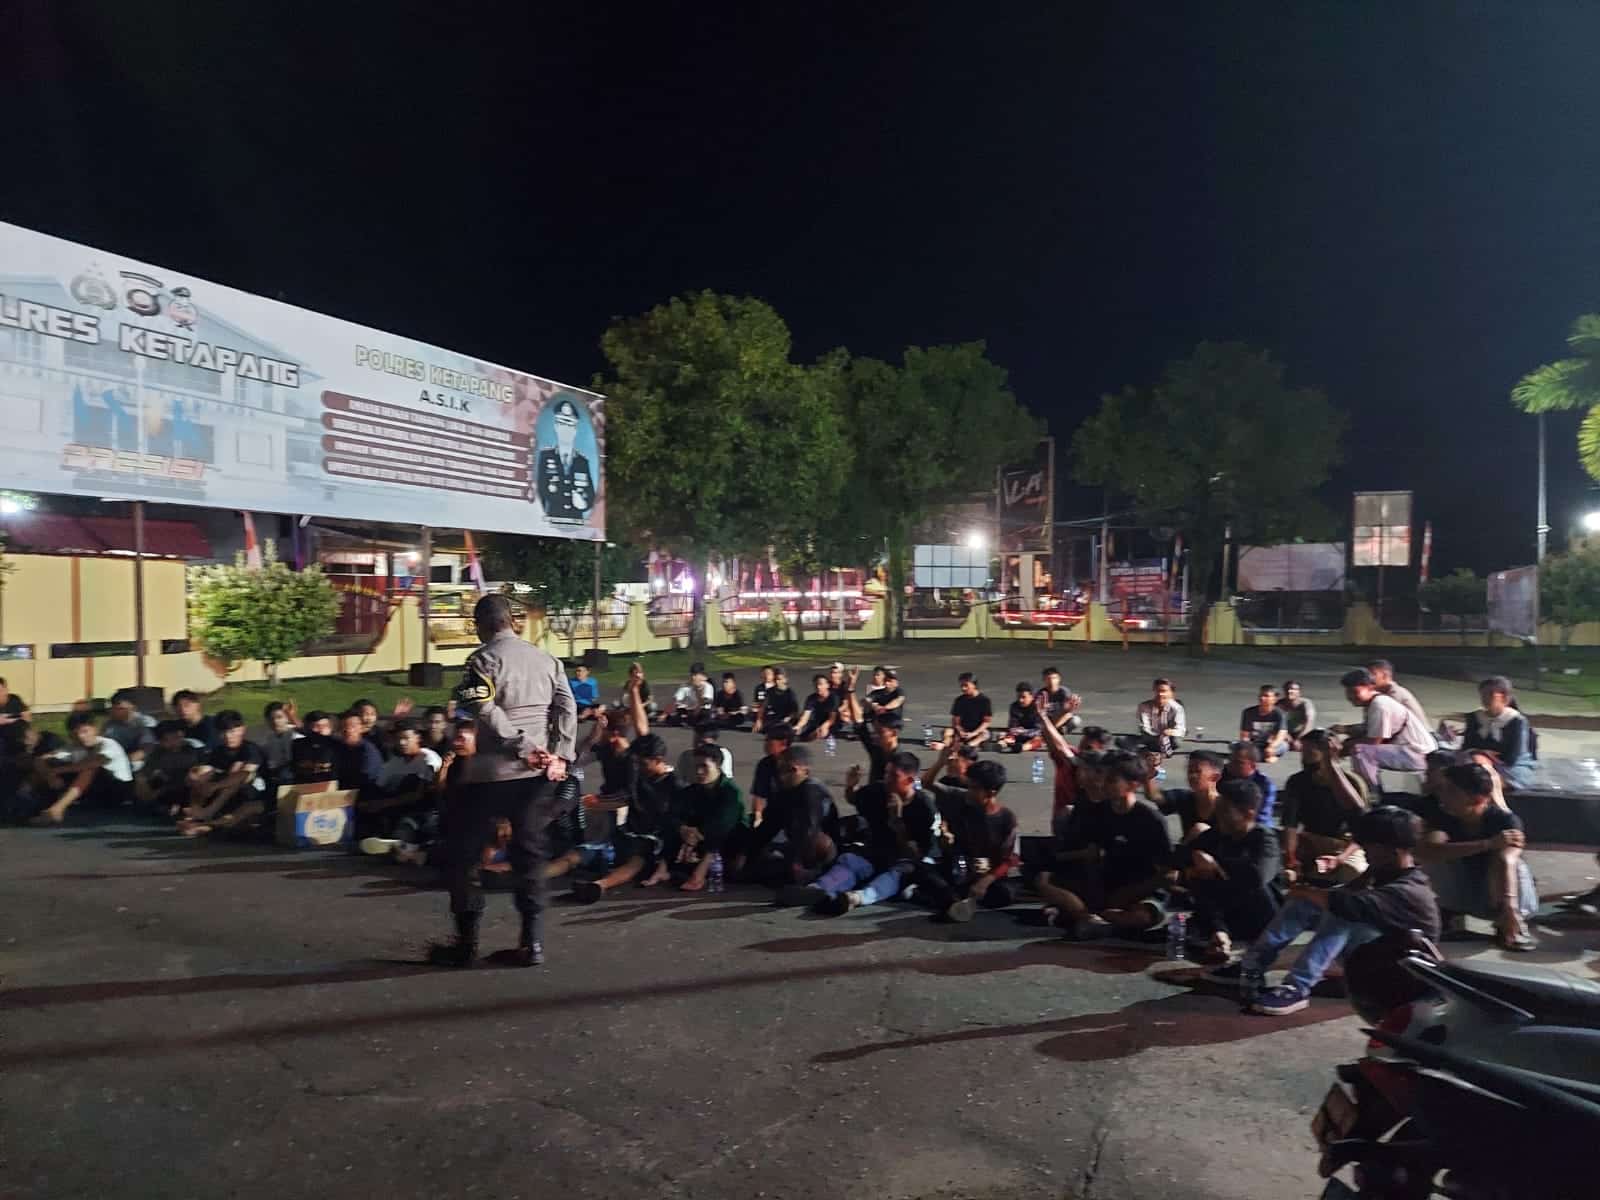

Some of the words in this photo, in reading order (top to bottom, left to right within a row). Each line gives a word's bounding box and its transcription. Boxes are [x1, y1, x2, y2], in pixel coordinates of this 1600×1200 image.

[119, 322, 300, 389] KETAPANG
[355, 344, 425, 382] POLRES
[430, 364, 513, 404] KETAPANG
